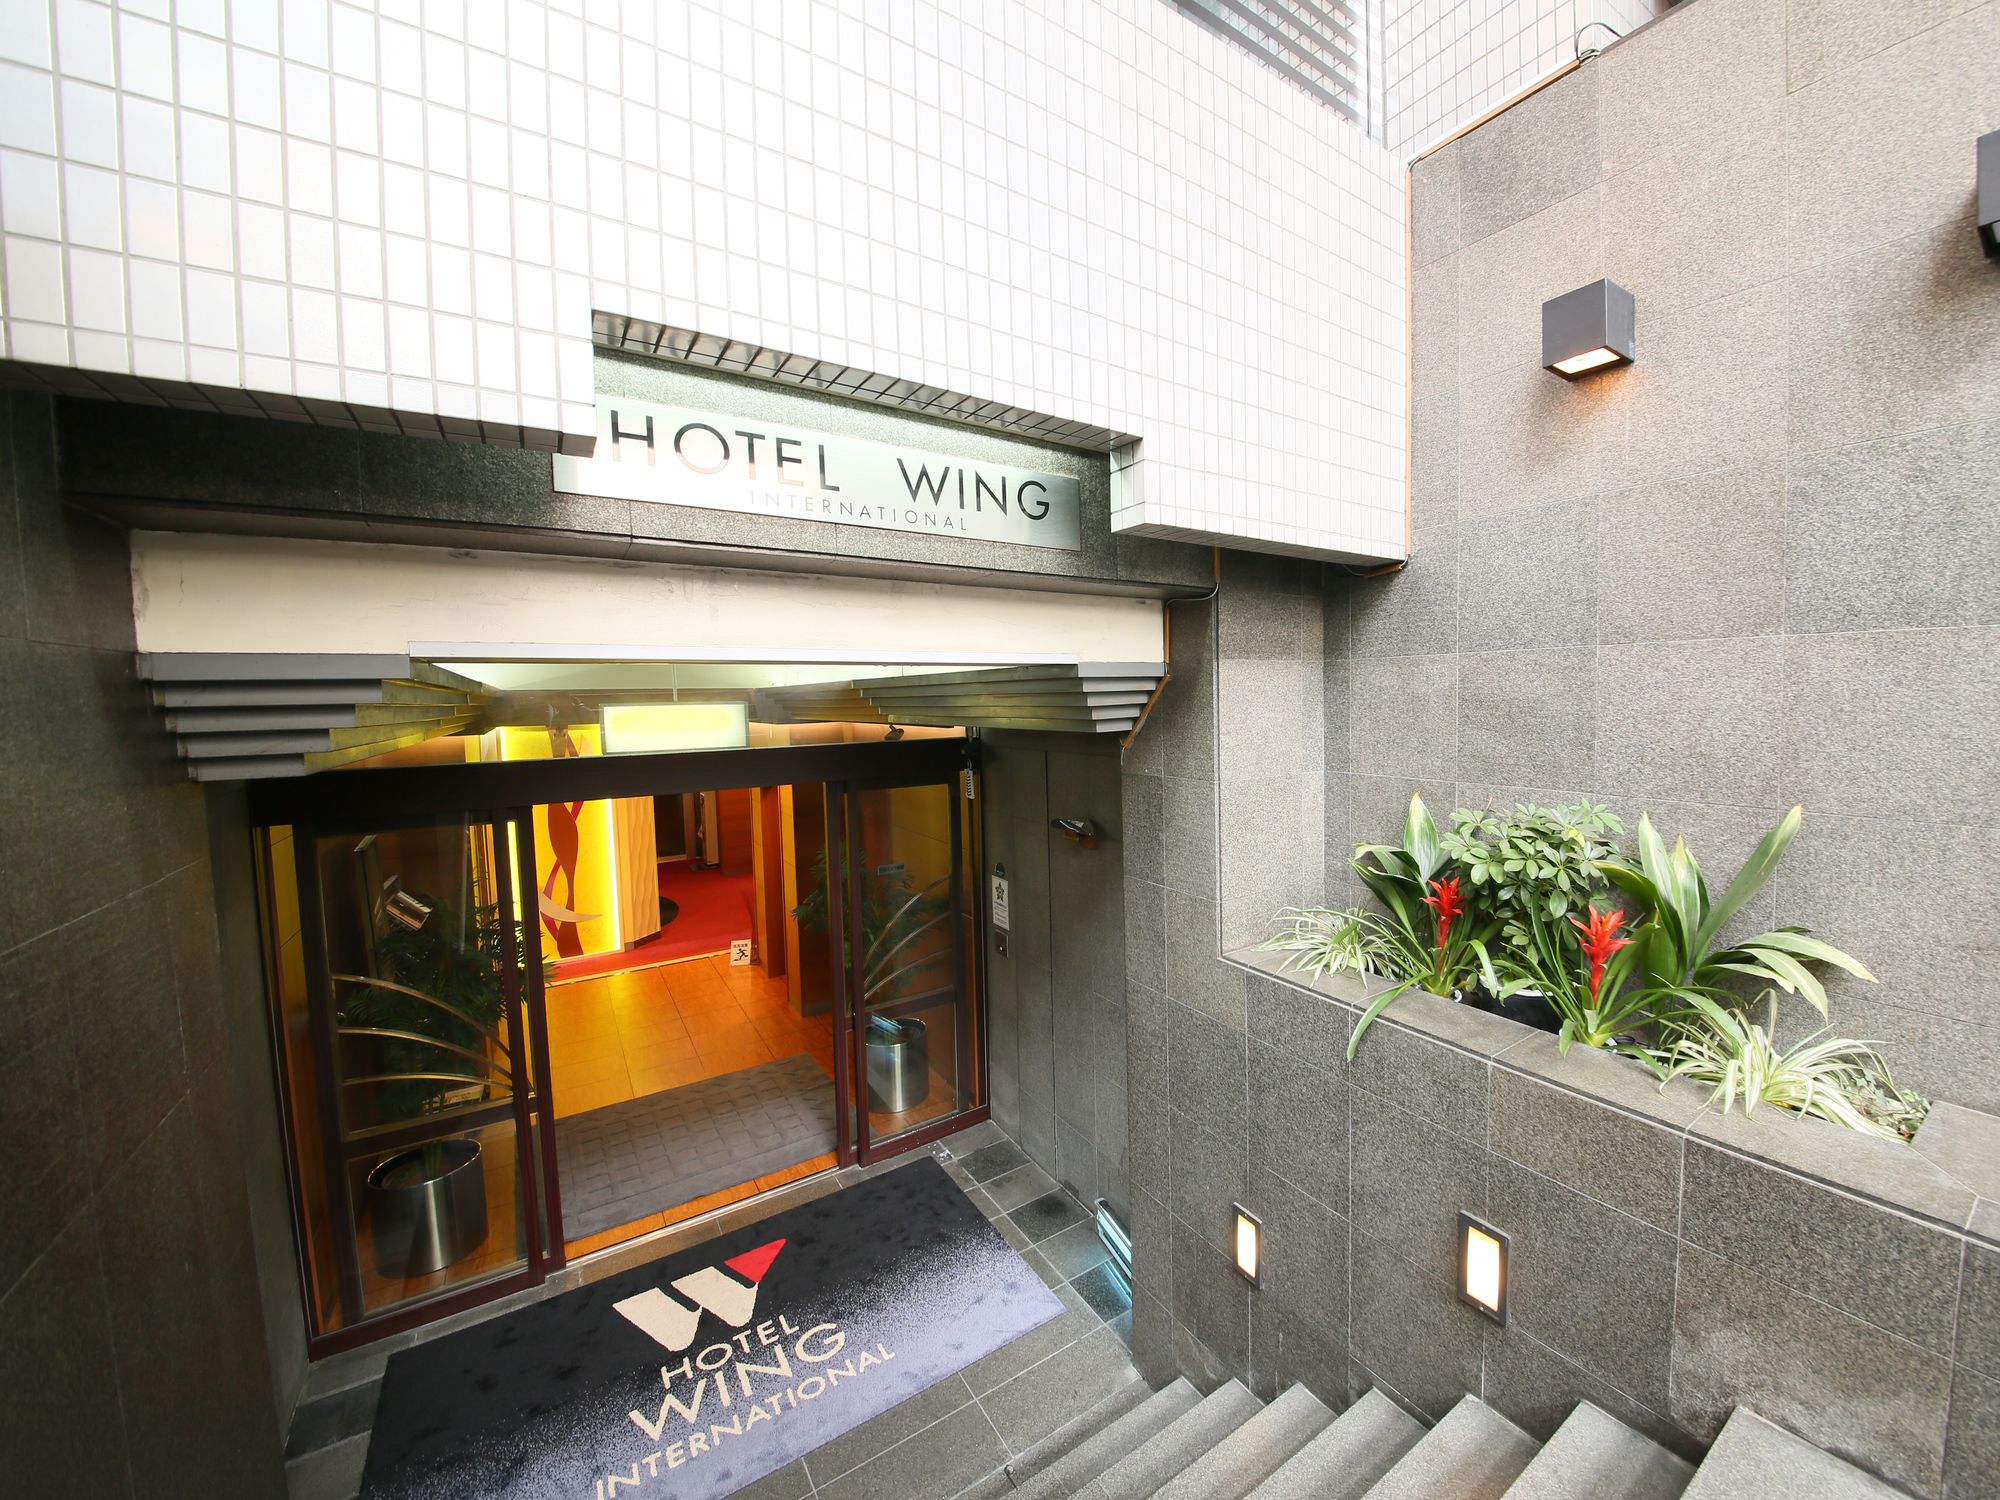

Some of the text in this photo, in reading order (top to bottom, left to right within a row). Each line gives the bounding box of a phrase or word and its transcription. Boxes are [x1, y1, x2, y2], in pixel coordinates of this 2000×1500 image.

[610, 409, 1051, 521] HOTEL WING
[750, 489, 967, 531] INTERNATIONAL
[628, 1322, 846, 1442] WING
[661, 1314, 799, 1391] HOTEL
[595, 1343, 896, 1500] INTERNATIONAL
